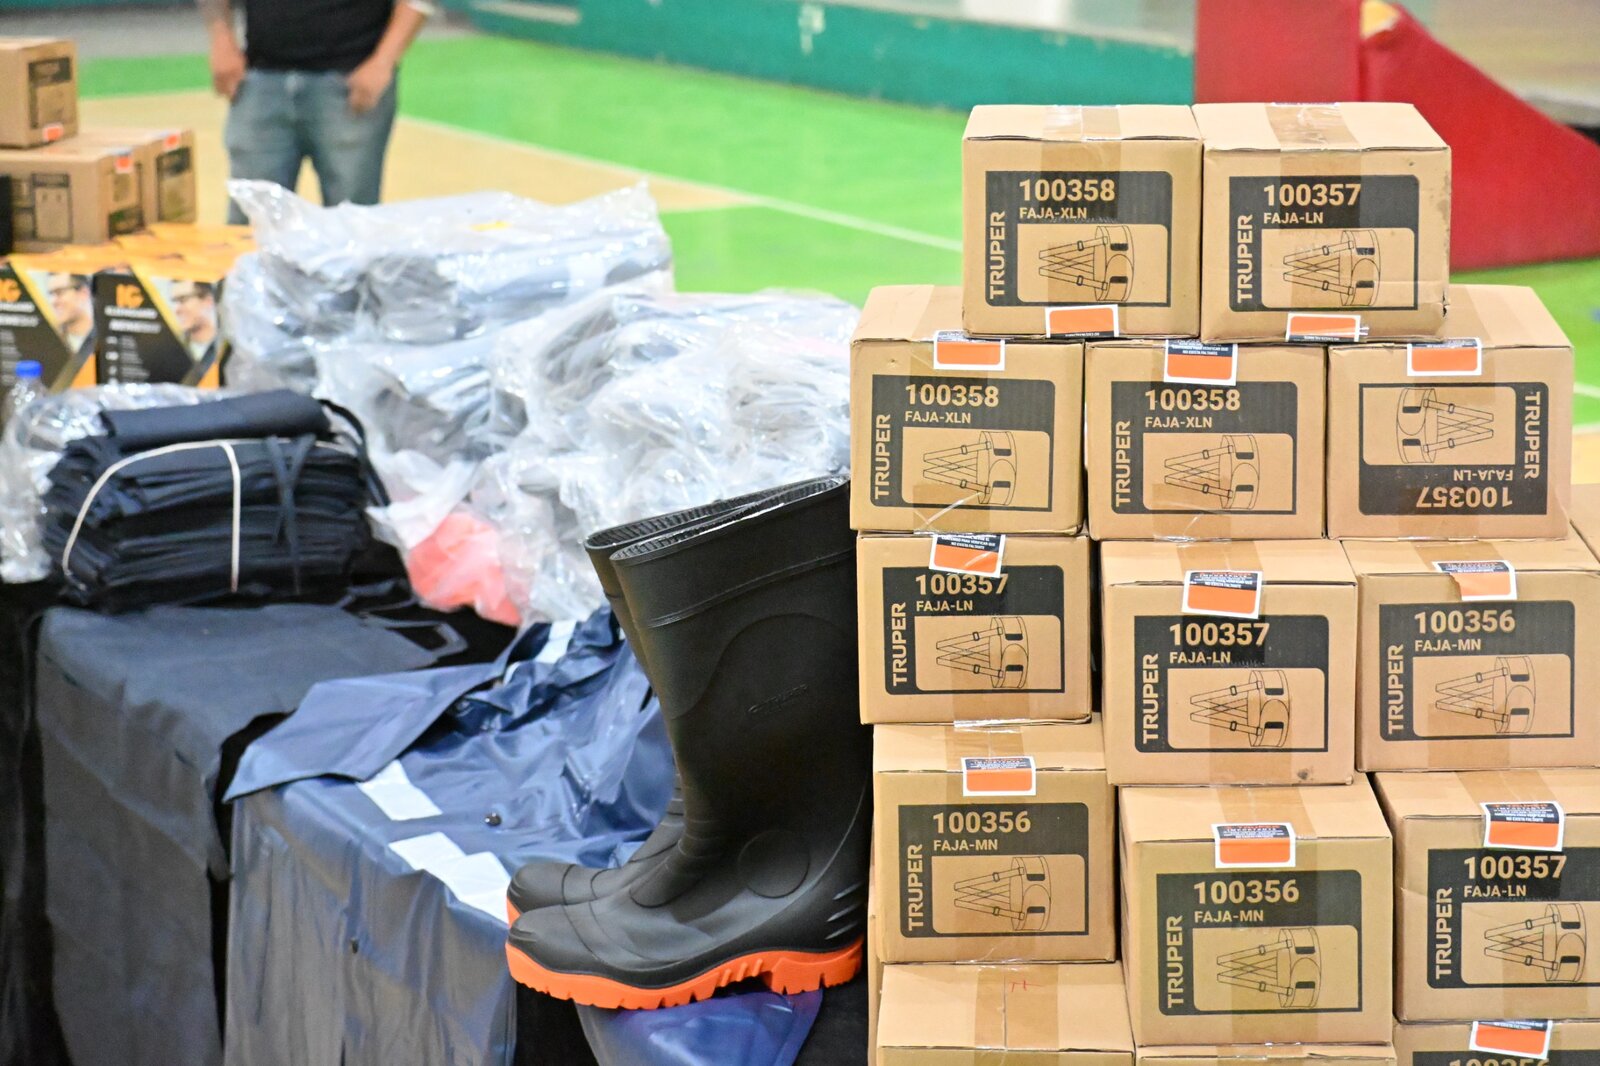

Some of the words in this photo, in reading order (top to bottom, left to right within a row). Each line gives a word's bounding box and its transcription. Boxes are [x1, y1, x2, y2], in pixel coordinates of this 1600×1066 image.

[1019, 179, 1115, 202] 100358
[1263, 184, 1361, 206] 100357
[1019, 207, 1087, 219] FAJA-XLN
[1263, 212, 1324, 224] FAJA-LN
[990, 211, 1006, 299] TRUPER
[1237, 214, 1253, 304] TRUPER
[905, 383, 999, 407] 100358
[1145, 389, 1241, 412] 100358
[904, 411, 971, 424] FAJA-XLN
[1145, 416, 1213, 428] FAJA-XLN
[1524, 391, 1540, 479] TRUPER
[874, 414, 891, 500] TRUPER
[1116, 421, 1131, 507] TRUPER
[1453, 469, 1513, 481] FAJA-LN
[1416, 486, 1513, 508] 100357
[915, 573, 1008, 595] 100357
[916, 600, 973, 611] FAJA-LN
[1414, 609, 1516, 634] 100356
[891, 602, 907, 687] TRUPER
[1169, 623, 1270, 646] 100357
[1415, 639, 1481, 652] FAJA-MN
[1170, 652, 1231, 664] FAJA-LN
[1143, 653, 1158, 744] TRUPER
[1388, 644, 1404, 734] TRUPER
[932, 810, 1031, 834] 100356
[933, 839, 998, 851] FAJA-MN
[1463, 855, 1567, 879] 100357
[907, 844, 923, 931] TRUPER
[1193, 879, 1299, 904] 100356
[1464, 885, 1527, 897] FAJA-LN
[1194, 910, 1264, 923] FAJA-MN
[1435, 887, 1452, 980] TRUPER
[1166, 915, 1184, 1008] TRUPER
